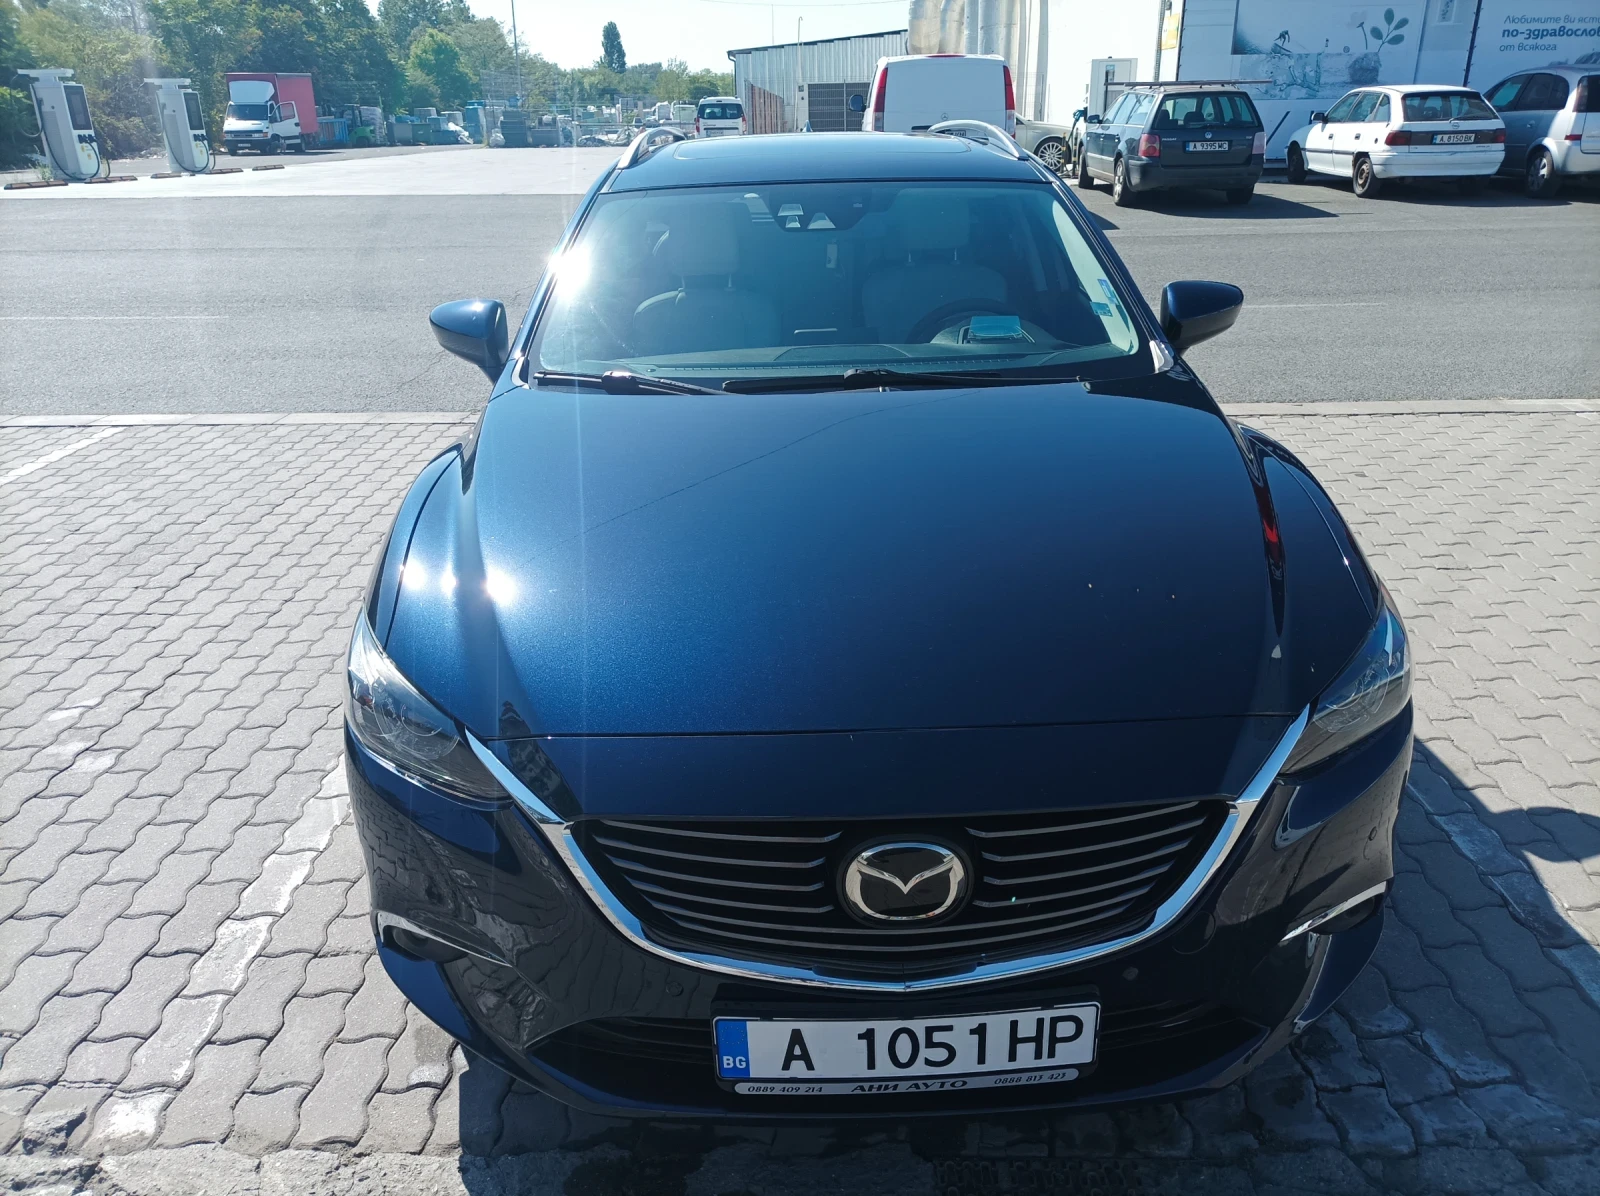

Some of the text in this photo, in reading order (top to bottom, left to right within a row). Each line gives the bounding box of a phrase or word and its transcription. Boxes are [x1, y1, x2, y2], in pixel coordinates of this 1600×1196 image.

[1503, 14, 1561, 24] Любимите
[1563, 14, 1575, 24] ви
[1499, 42, 1557, 52] от всякога
[781, 1014, 1084, 1071] A 1051 HP
[722, 1055, 747, 1069] BG
[994, 1072, 1066, 1085] 0888 813 423
[747, 1085, 823, 1094] 0889 409 214
[851, 1079, 968, 1093] АНИ АУТО
